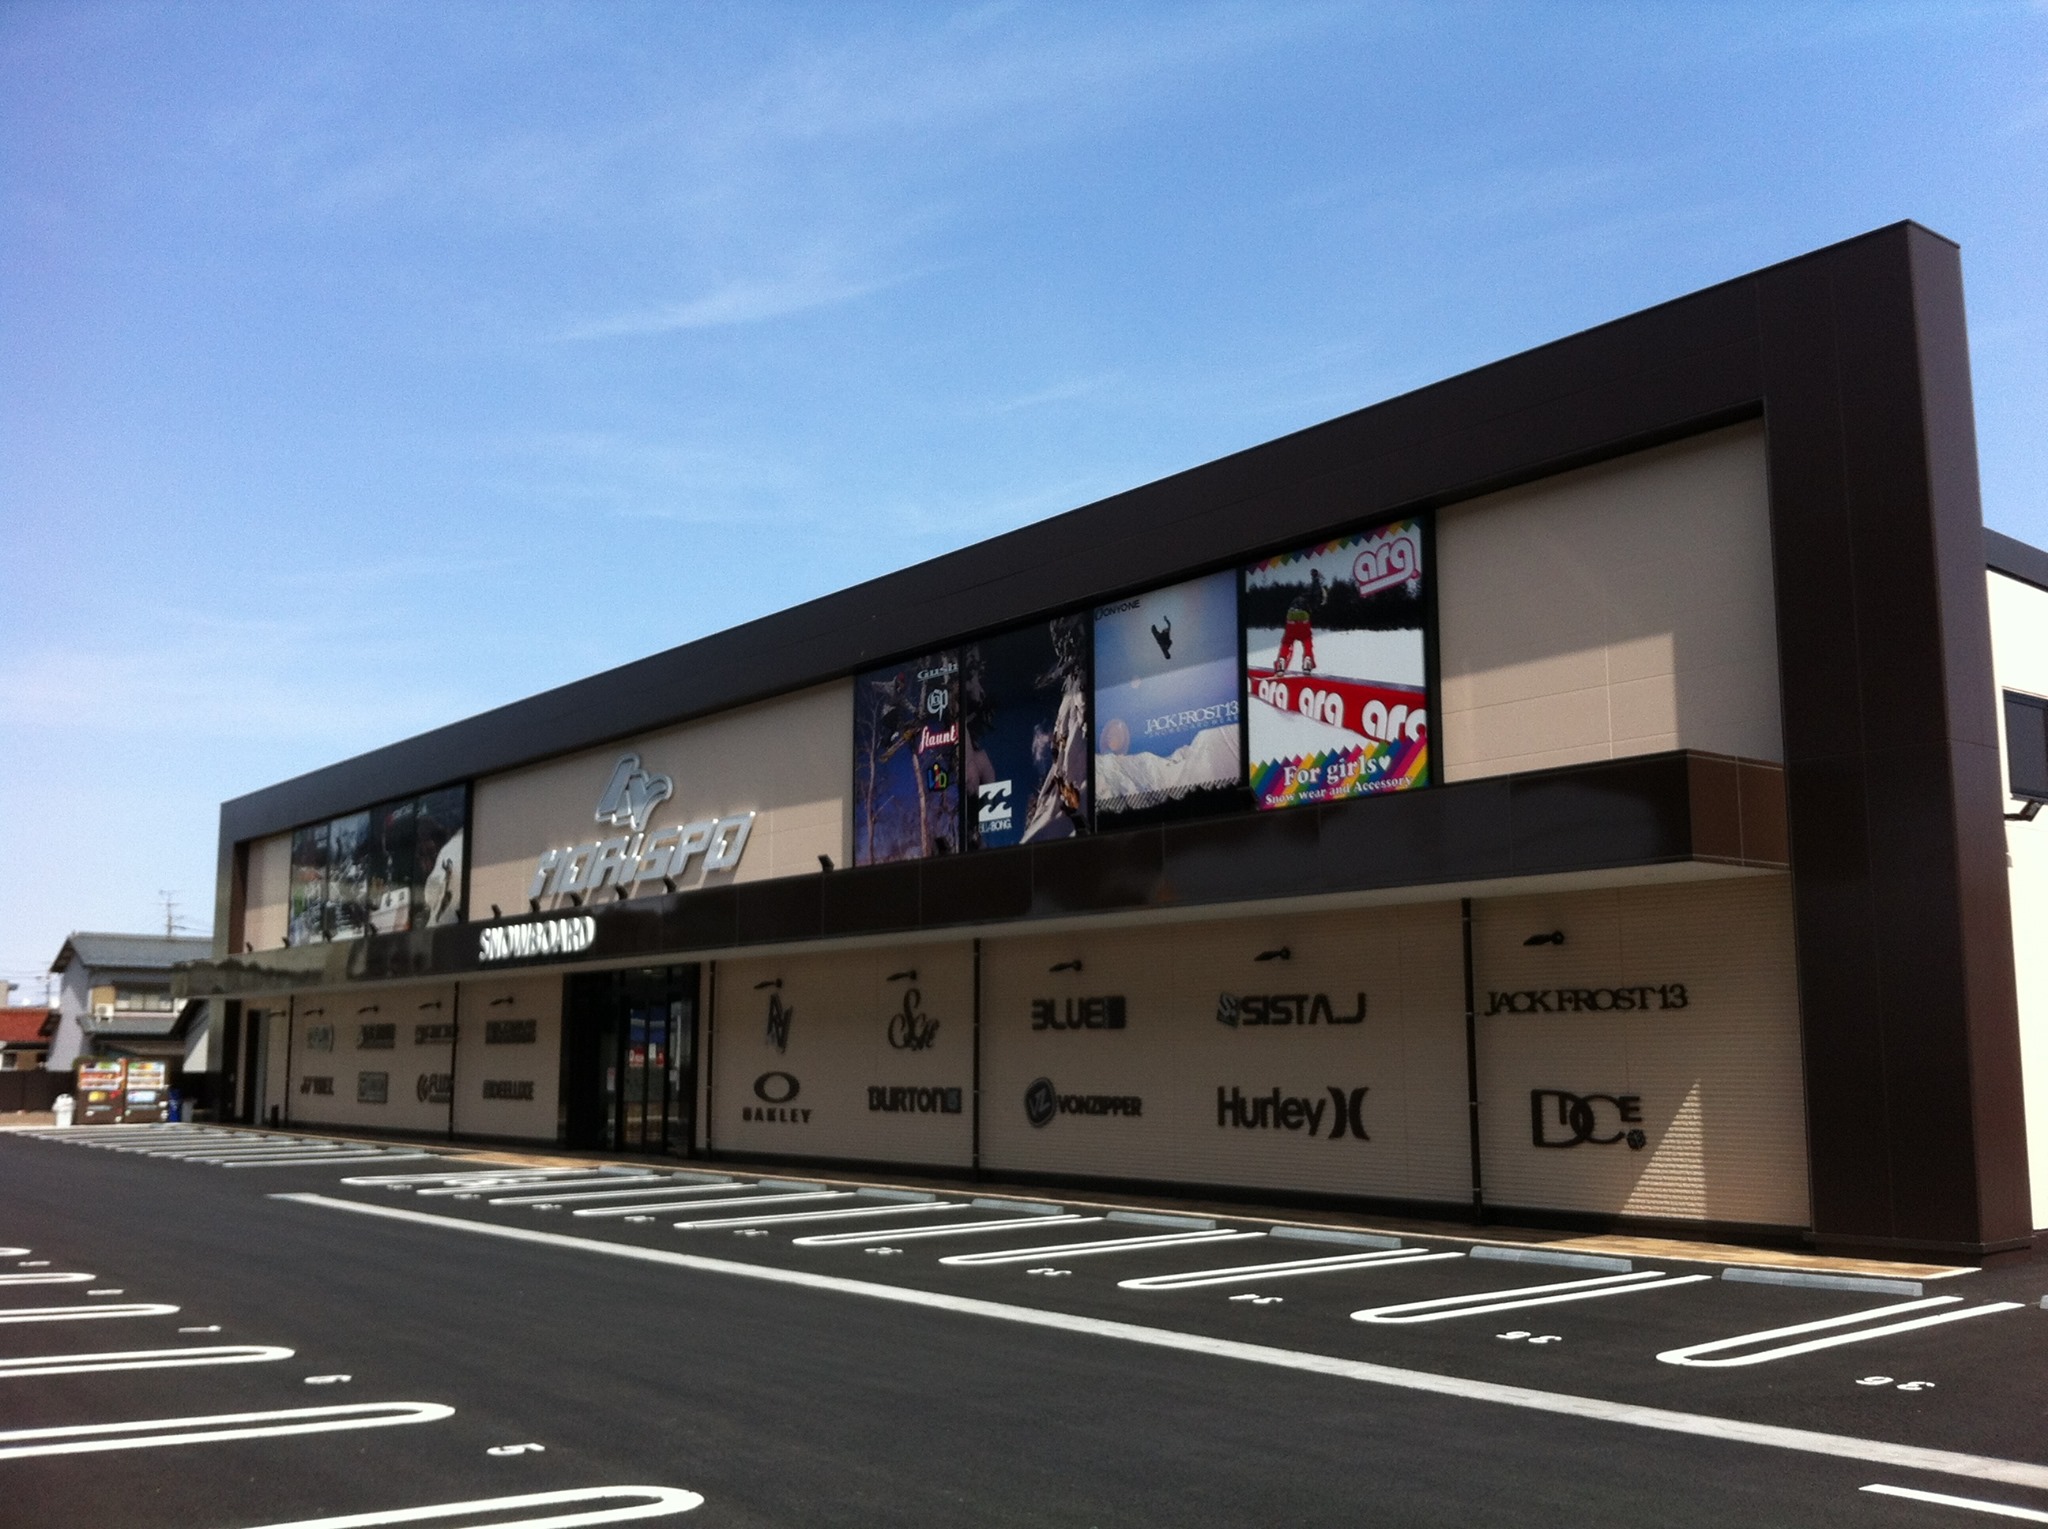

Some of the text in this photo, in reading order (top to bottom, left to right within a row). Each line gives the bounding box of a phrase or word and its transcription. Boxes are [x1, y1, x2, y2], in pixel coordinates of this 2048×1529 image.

[1144, 713, 1178, 735] JACK
[1283, 754, 1377, 789] For girls
[1265, 775, 1413, 805] Snow wear and Accessory
[478, 915, 597, 962] SNOWBOARD
[1485, 989, 1553, 1016] JACK
[1556, 986, 1656, 1012] FROST
[742, 1107, 812, 1123] OAKLEY
[1057, 1093, 1143, 1117] VONZIPPER
[1217, 1086, 1326, 1136] Hurley
